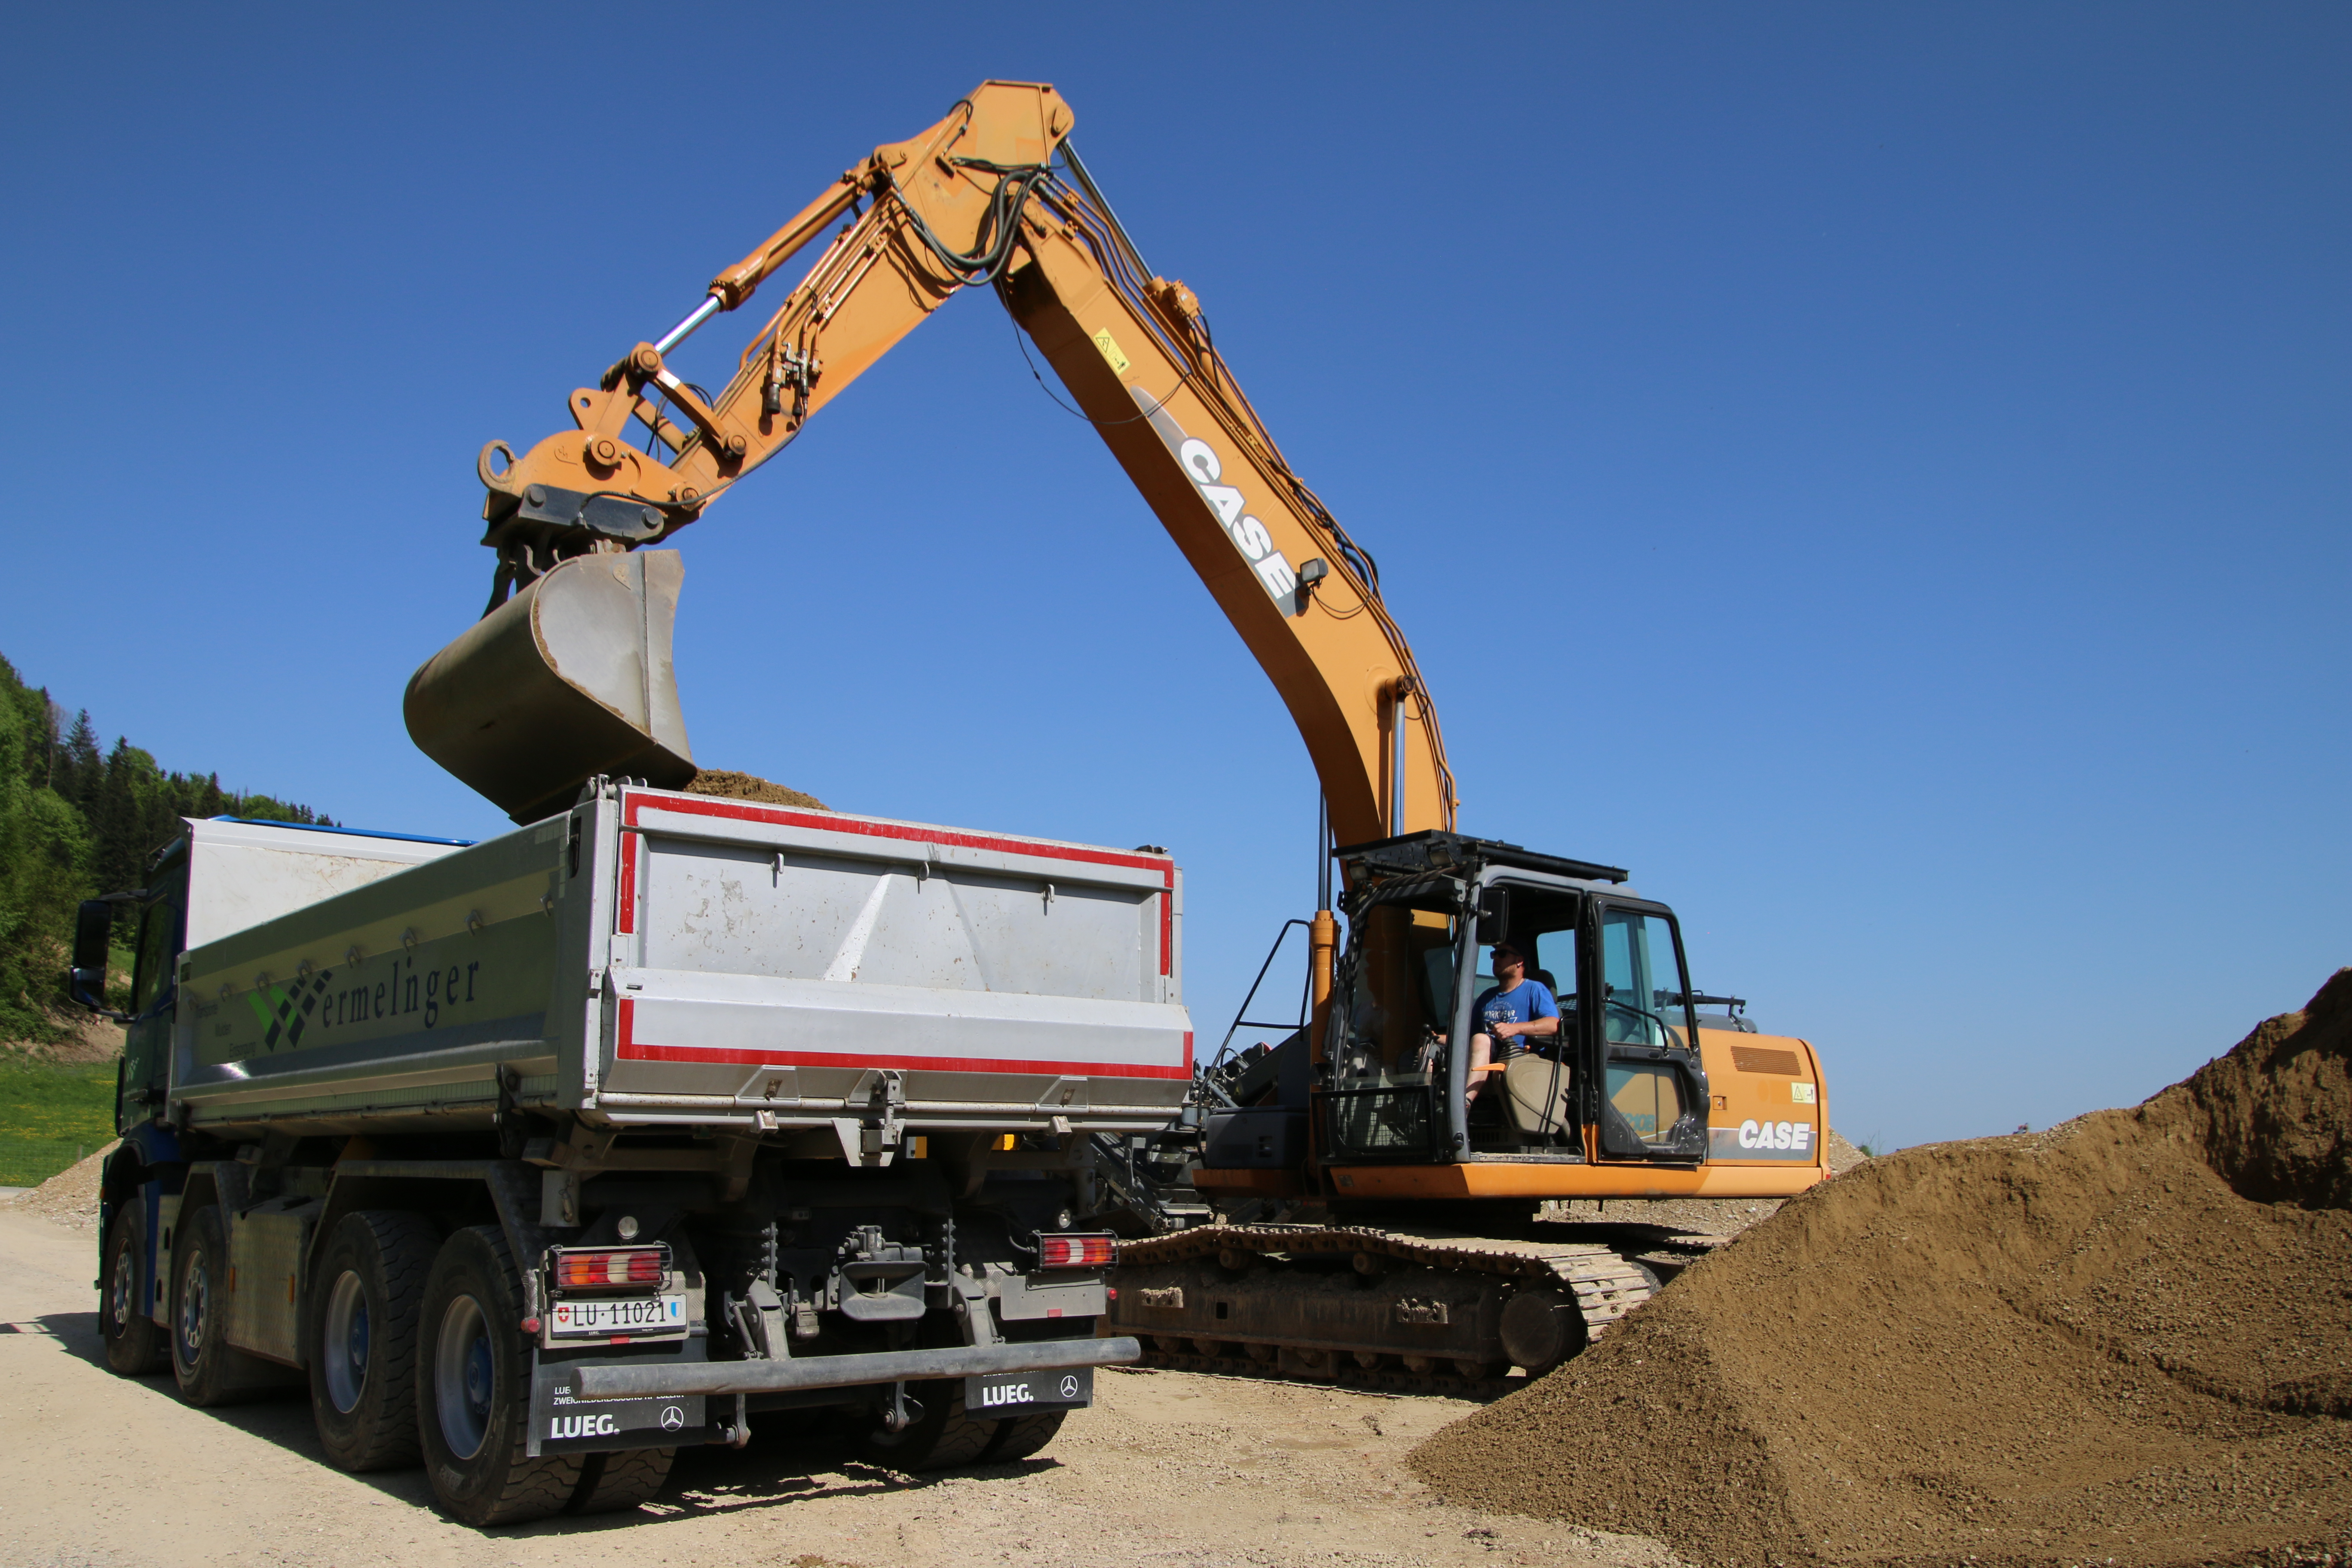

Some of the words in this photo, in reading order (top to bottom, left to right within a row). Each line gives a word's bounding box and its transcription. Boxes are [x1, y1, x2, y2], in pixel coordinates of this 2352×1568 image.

[1180, 438, 1300, 599] CASE
[1739, 1119, 1811, 1150] CASE
[554, 1387, 571, 1395] LUE
[983, 1383, 1034, 1406] LUEG.
[551, 1414, 620, 1439] LUEG.
